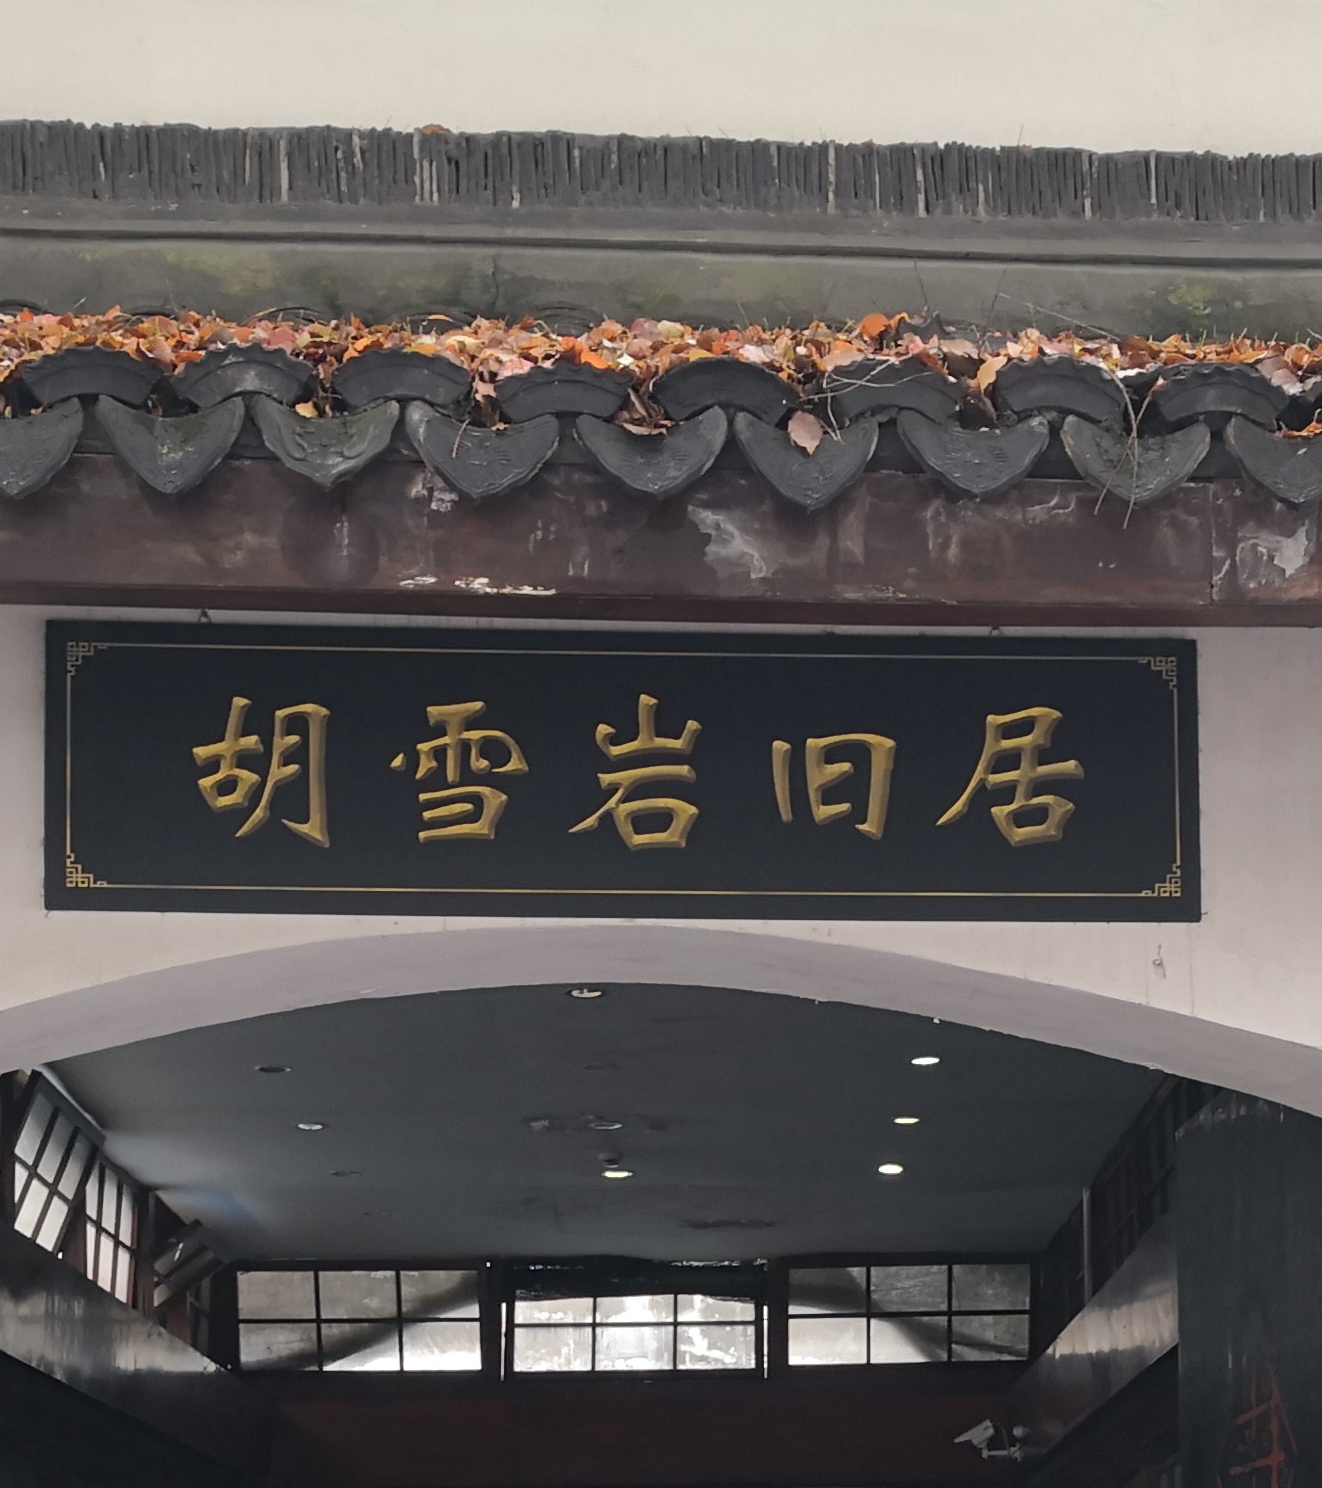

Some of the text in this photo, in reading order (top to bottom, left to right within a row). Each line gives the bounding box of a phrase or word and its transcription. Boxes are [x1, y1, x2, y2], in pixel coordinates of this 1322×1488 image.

[191, 692, 1085, 848] 胡雪岩旧居
